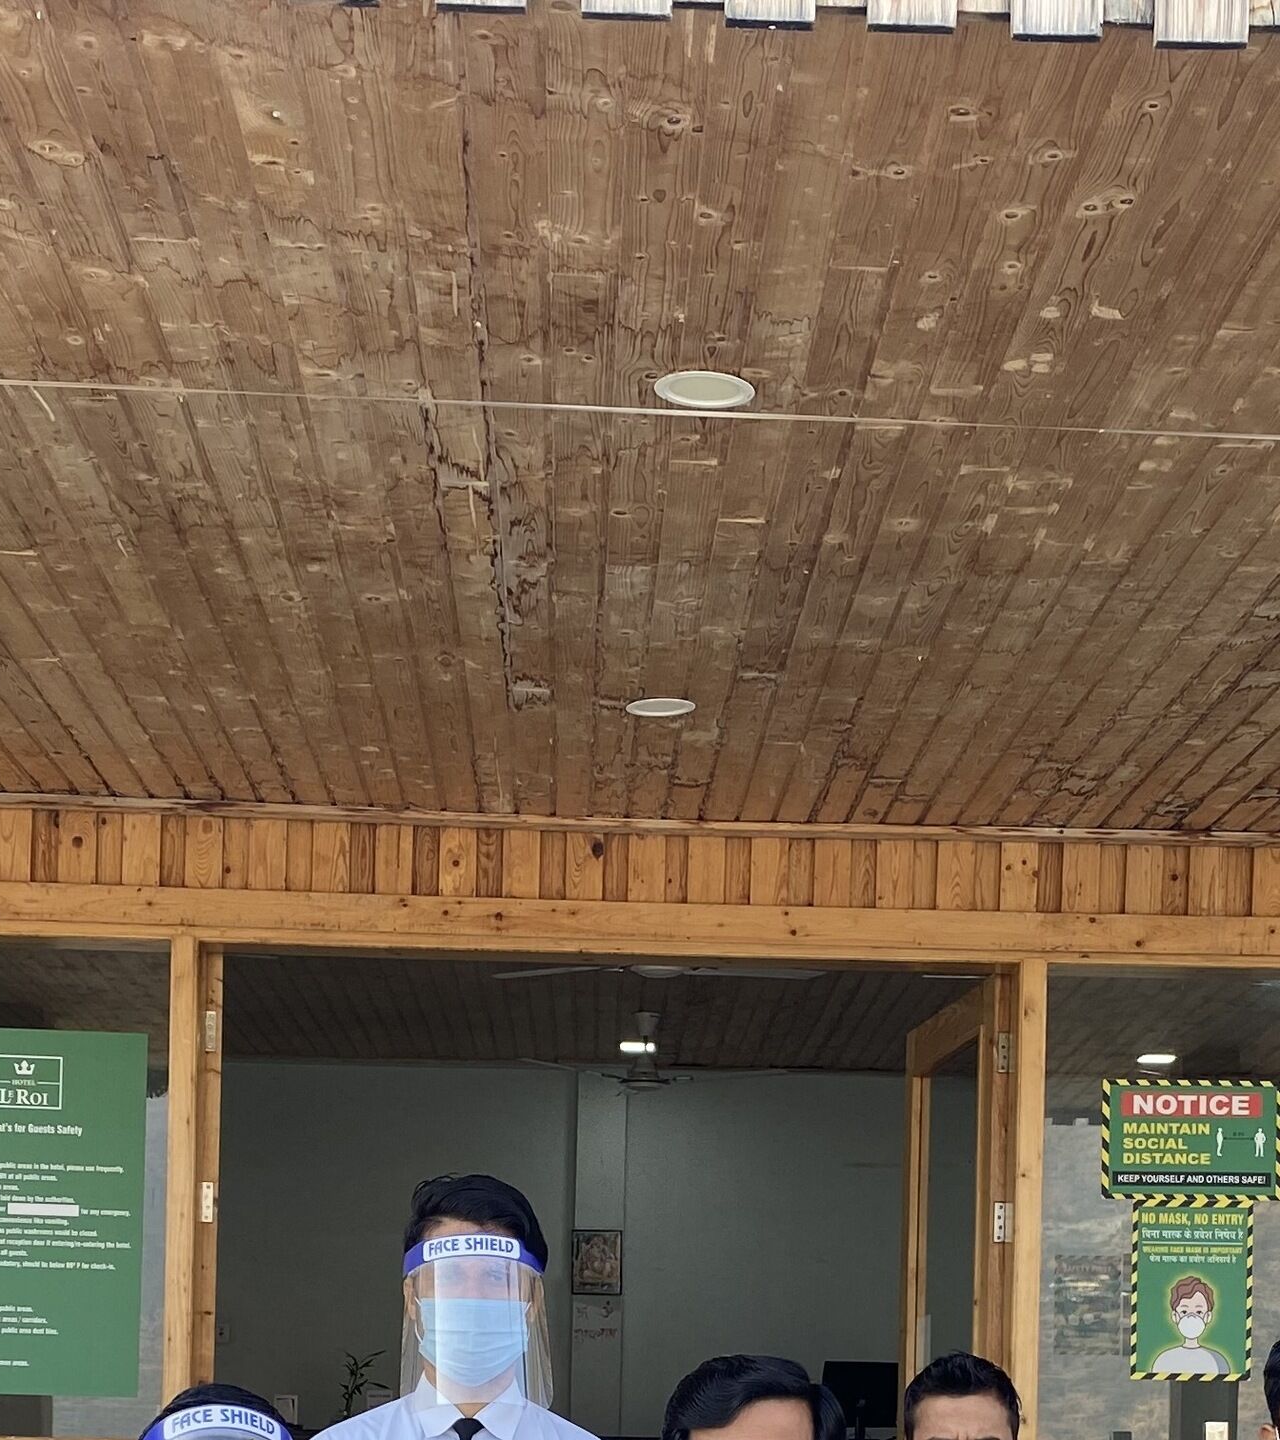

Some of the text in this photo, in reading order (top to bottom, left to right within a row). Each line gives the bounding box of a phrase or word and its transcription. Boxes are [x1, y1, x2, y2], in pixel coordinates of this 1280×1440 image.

[1133, 1095, 1250, 1116] NOTICE
[15, 1123, 25, 1133] for
[28, 1124, 55, 1134] Guests
[57, 1124, 83, 1137] Safety
[1123, 1123, 1210, 1135] MAINTAIN
[1123, 1138, 1188, 1150] SOCIAL
[1123, 1153, 1211, 1165] DISTANCE
[1117, 1174, 1266, 1184] KEEP YOURSELF AND OTHERS SAFE!
[1142, 1212, 1244, 1226] NO MASK, NO ENTRY
[1142, 1227, 1160, 1239] बिना
[1183, 1228, 1192, 1239] के
[1238, 1228, 1244, 1241] है
[429, 1238, 514, 1257] FACE SHIELD
[171, 1409, 275, 1435] FACE SHIELD
